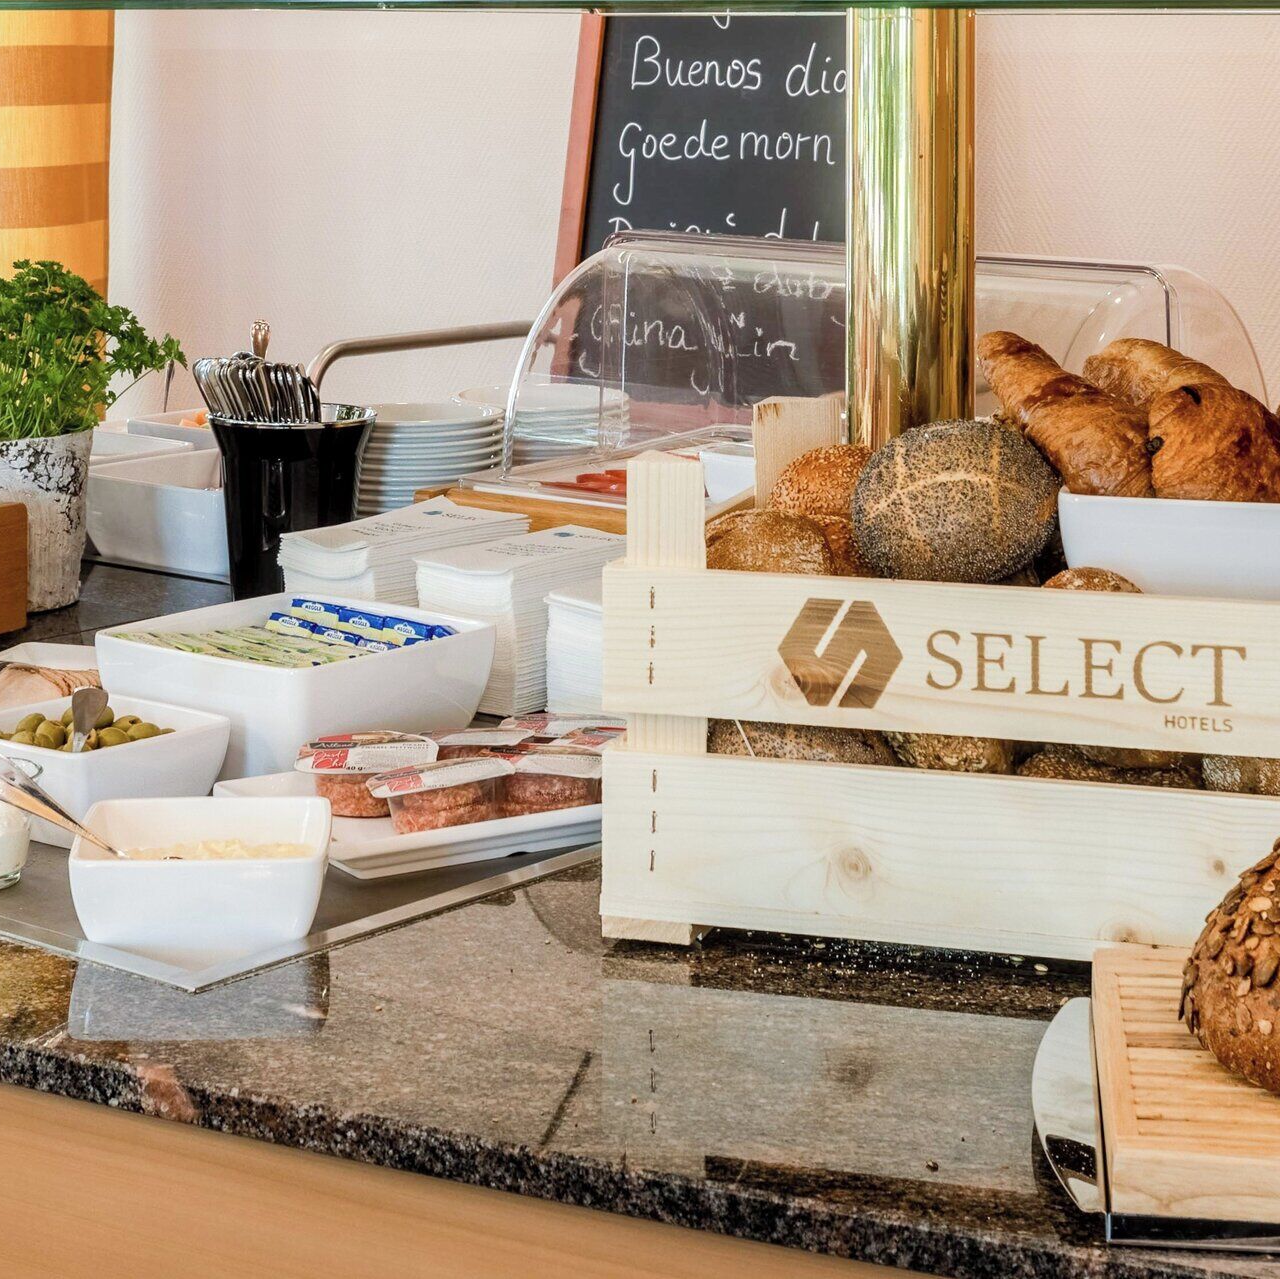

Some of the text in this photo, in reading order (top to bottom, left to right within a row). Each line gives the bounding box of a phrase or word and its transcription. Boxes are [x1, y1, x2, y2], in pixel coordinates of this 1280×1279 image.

[631, 35, 762, 91] Buenos
[924, 629, 1247, 708] SELECT
[1163, 714, 1234, 733] HOTELS
